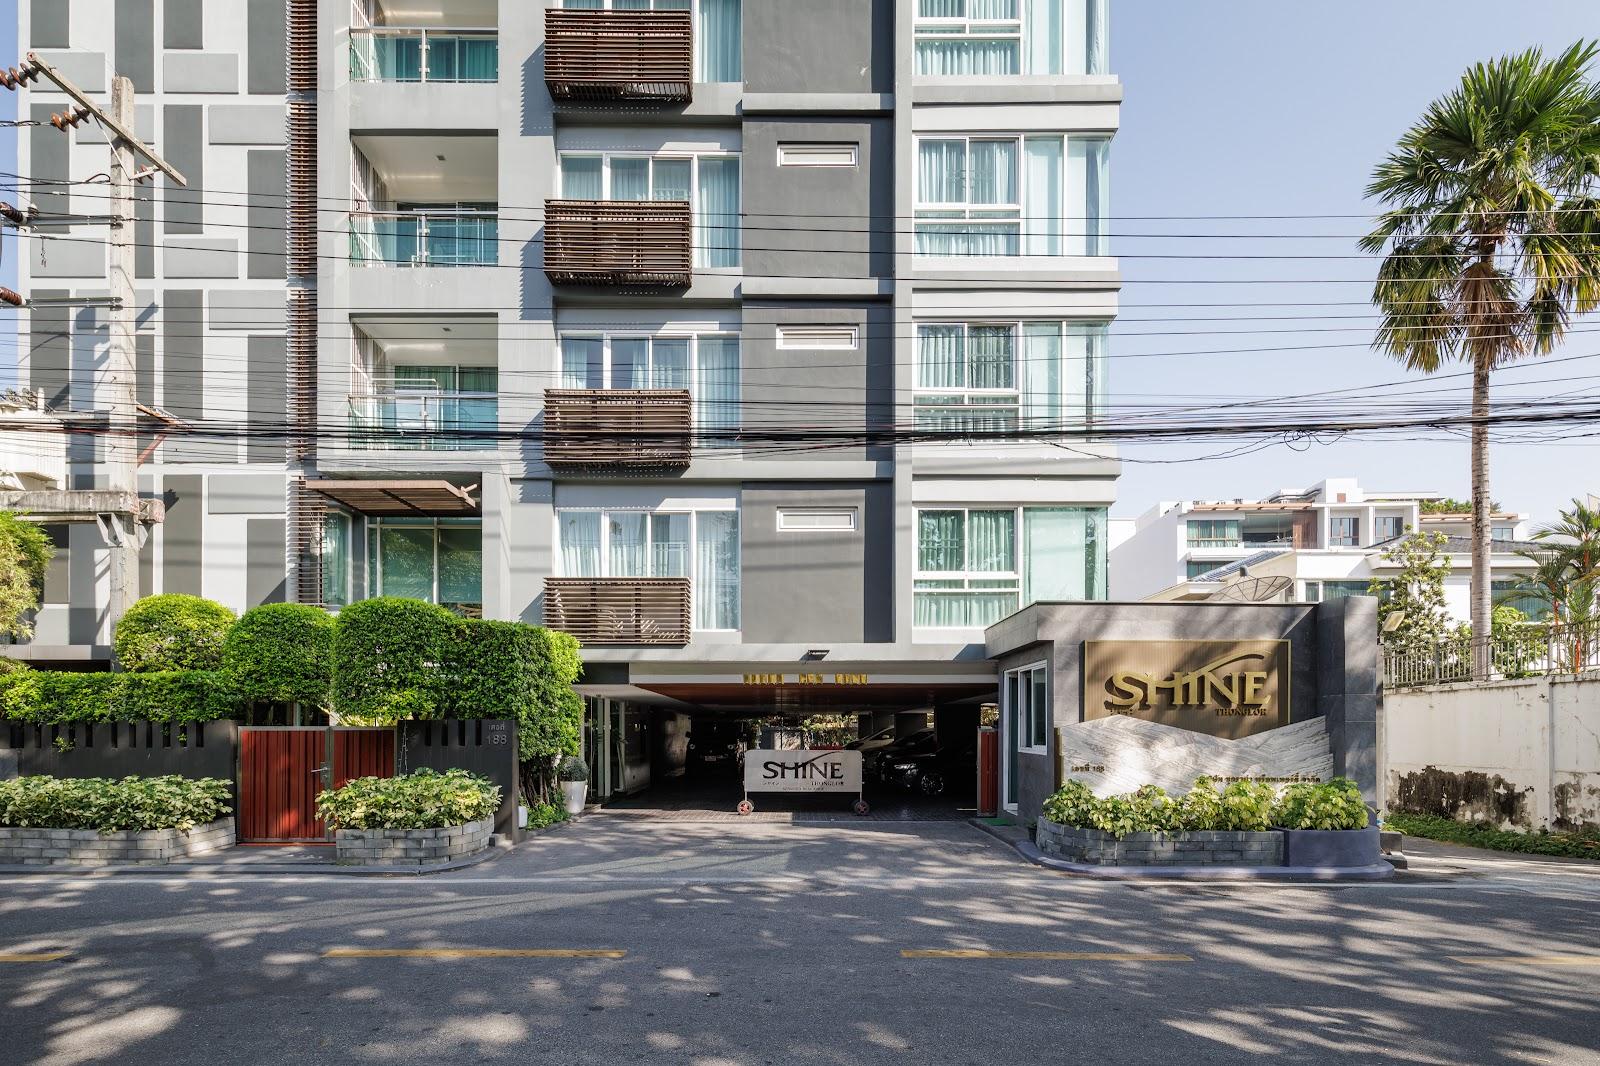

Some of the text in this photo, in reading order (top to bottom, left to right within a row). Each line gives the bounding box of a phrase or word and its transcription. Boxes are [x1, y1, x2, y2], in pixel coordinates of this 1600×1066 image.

[1112, 671, 1271, 705] SHINE
[486, 734, 507, 745] 188
[762, 761, 844, 779] SHINE
